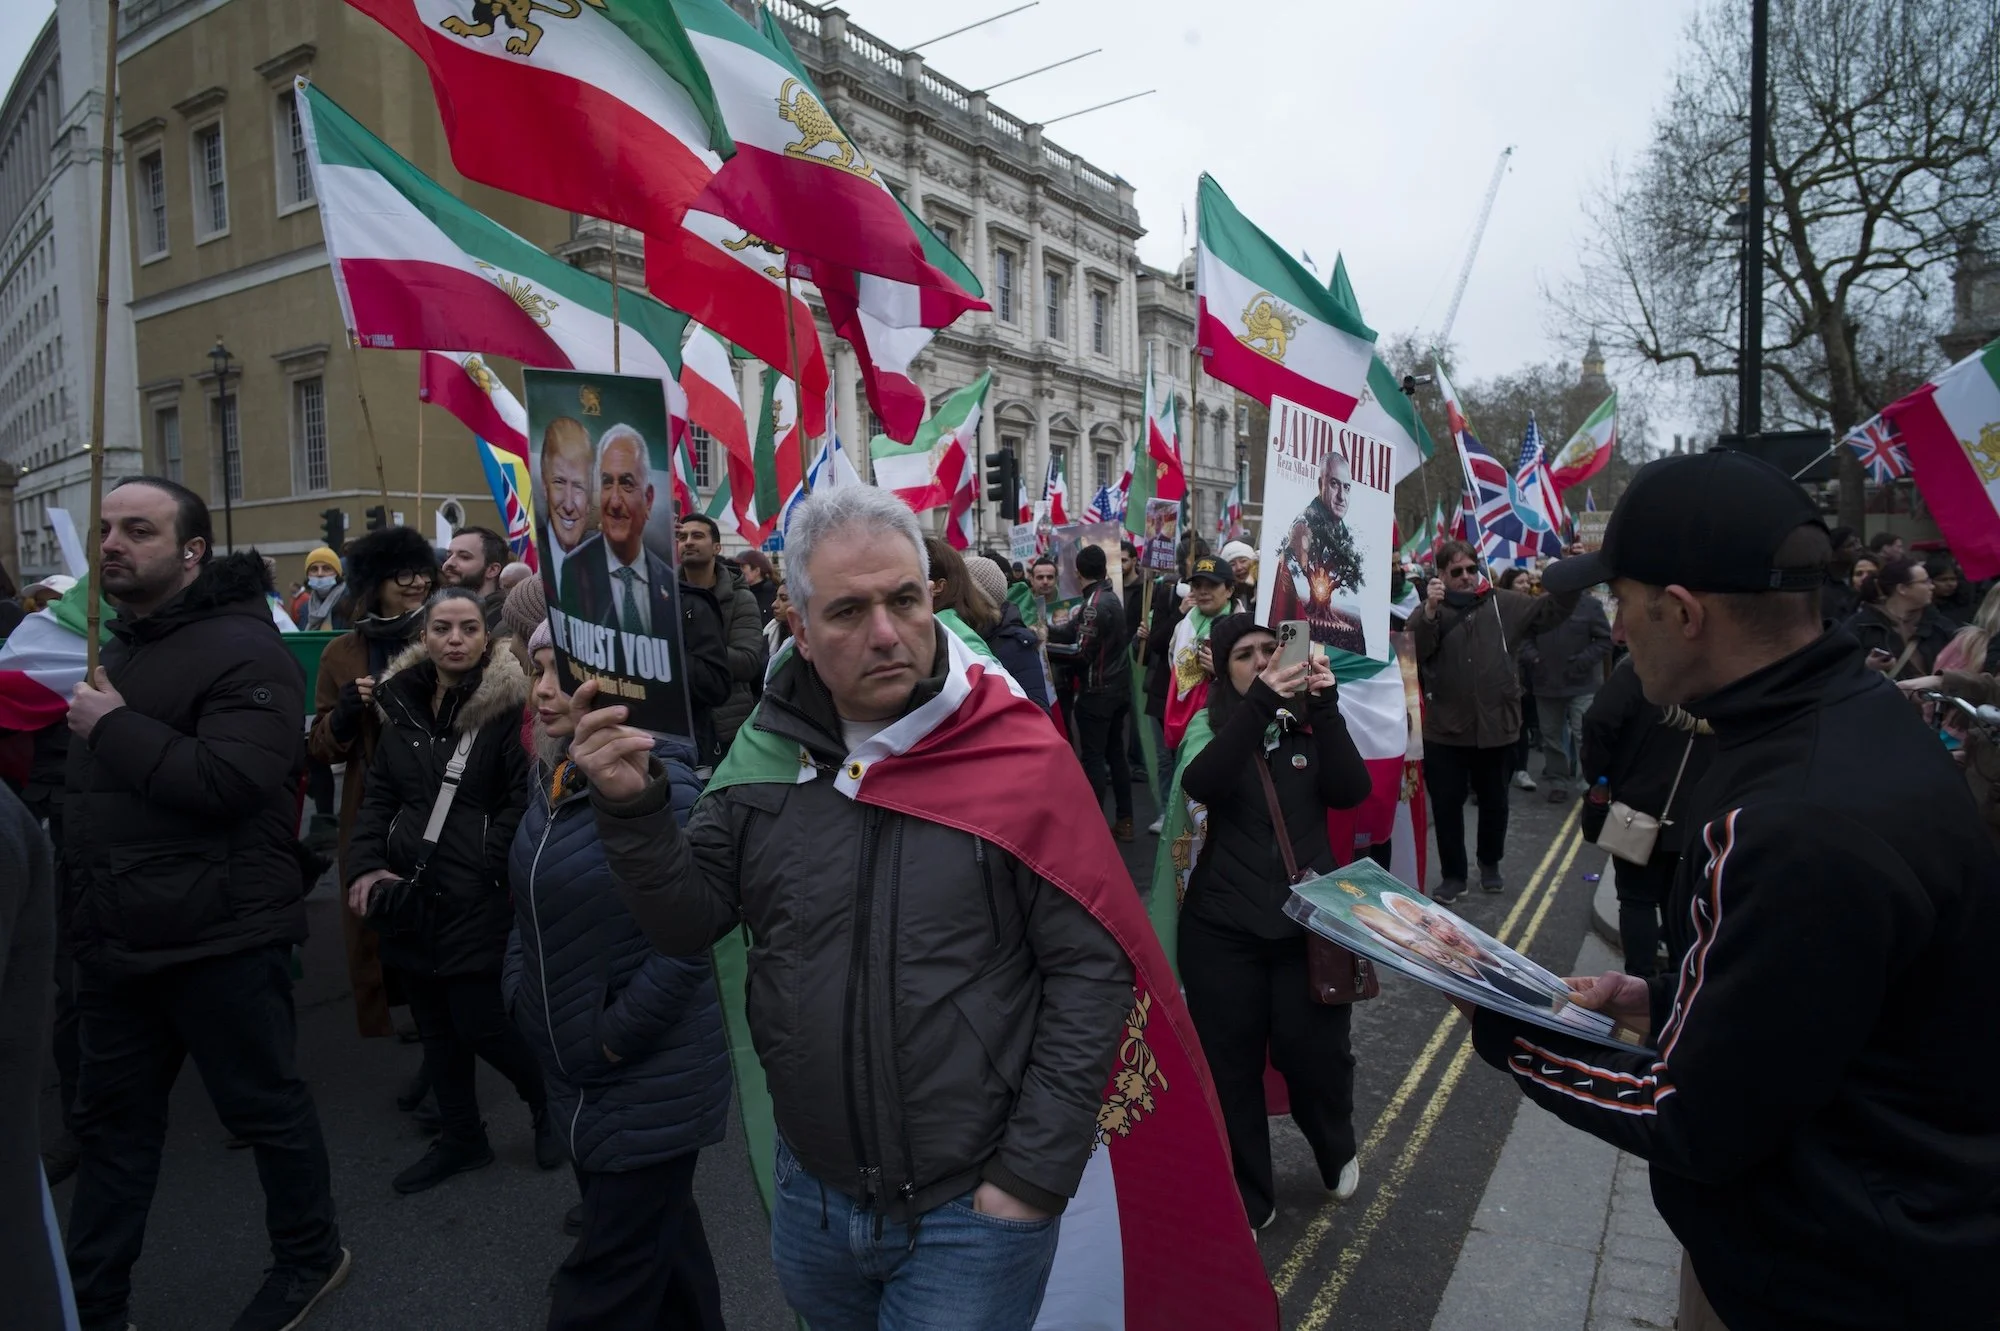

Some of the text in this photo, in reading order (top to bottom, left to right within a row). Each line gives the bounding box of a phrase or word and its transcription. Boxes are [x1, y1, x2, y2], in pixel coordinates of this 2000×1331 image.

[549, 605, 671, 683] WE TRUST YOU
[618, 677, 646, 700] Future
